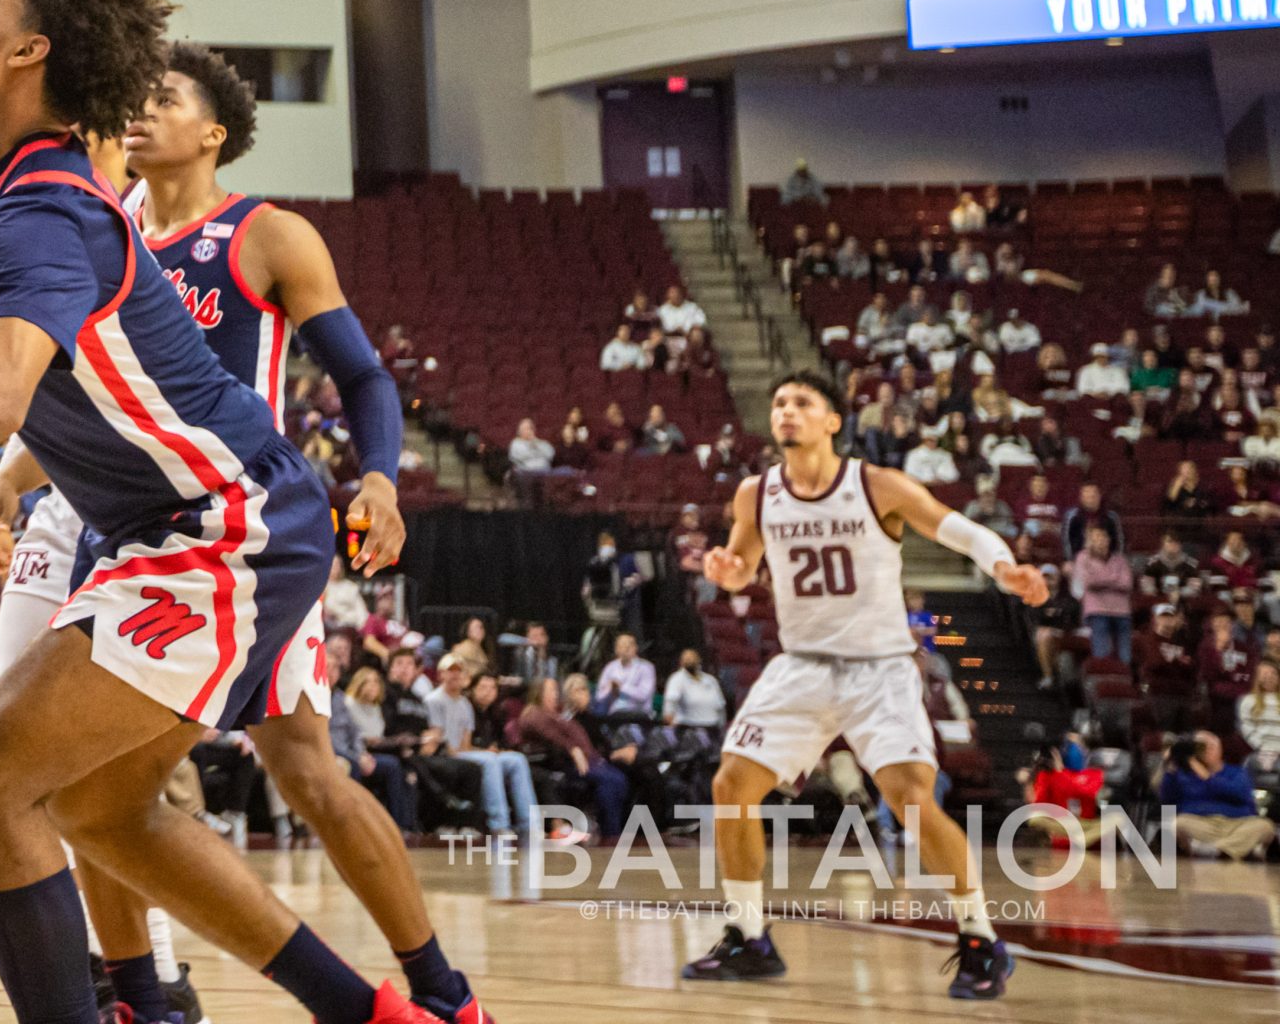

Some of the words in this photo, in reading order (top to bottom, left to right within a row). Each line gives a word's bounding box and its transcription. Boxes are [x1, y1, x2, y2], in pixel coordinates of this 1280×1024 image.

[768, 521, 824, 540] TEXAS
[831, 519, 865, 536] A&M
[789, 545, 857, 597] 20
